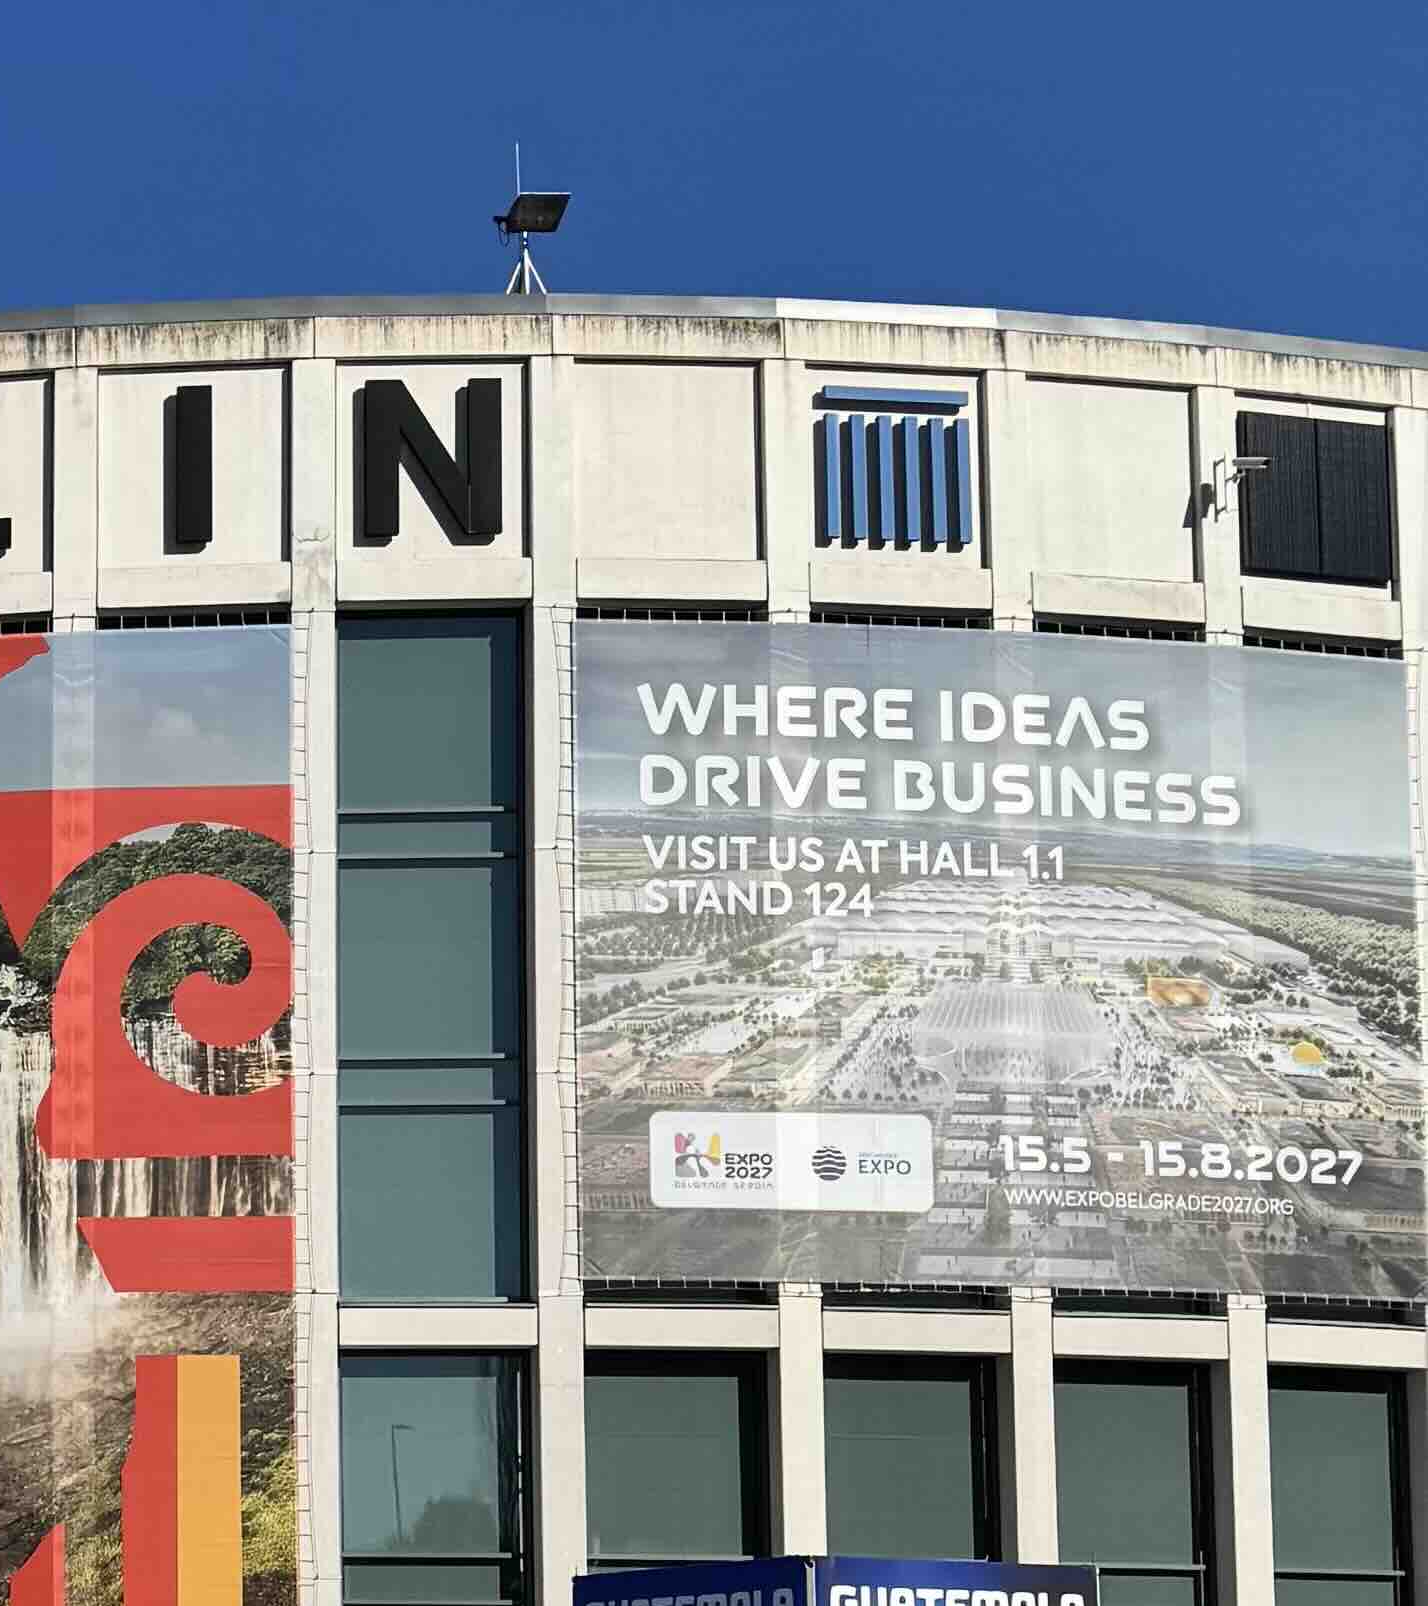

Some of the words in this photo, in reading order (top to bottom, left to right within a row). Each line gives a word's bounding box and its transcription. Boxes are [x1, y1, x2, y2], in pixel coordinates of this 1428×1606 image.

[637, 683, 913, 740] WHERE
[940, 690, 1149, 751] IDEAS
[639, 755, 867, 810] DRIVE
[894, 759, 1241, 826] BUSINESS
[642, 835, 756, 872] VISIT
[768, 837, 825, 872] US
[834, 838, 888, 873] AT
[900, 840, 1015, 877] HALL
[1021, 844, 1065, 880] 1.1
[643, 878, 792, 916] STAND
[804, 882, 875, 918] 124
[725, 1153, 773, 1166] EXPO
[725, 1166, 773, 1179] 2027
[858, 1159, 912, 1175] EXPO
[998, 1135, 1092, 1174] 15.5
[1140, 1141, 1364, 1186] 15.8.2027
[1003, 1188, 1294, 1216] WWW.EXPOBELGRADE2027.ORG
